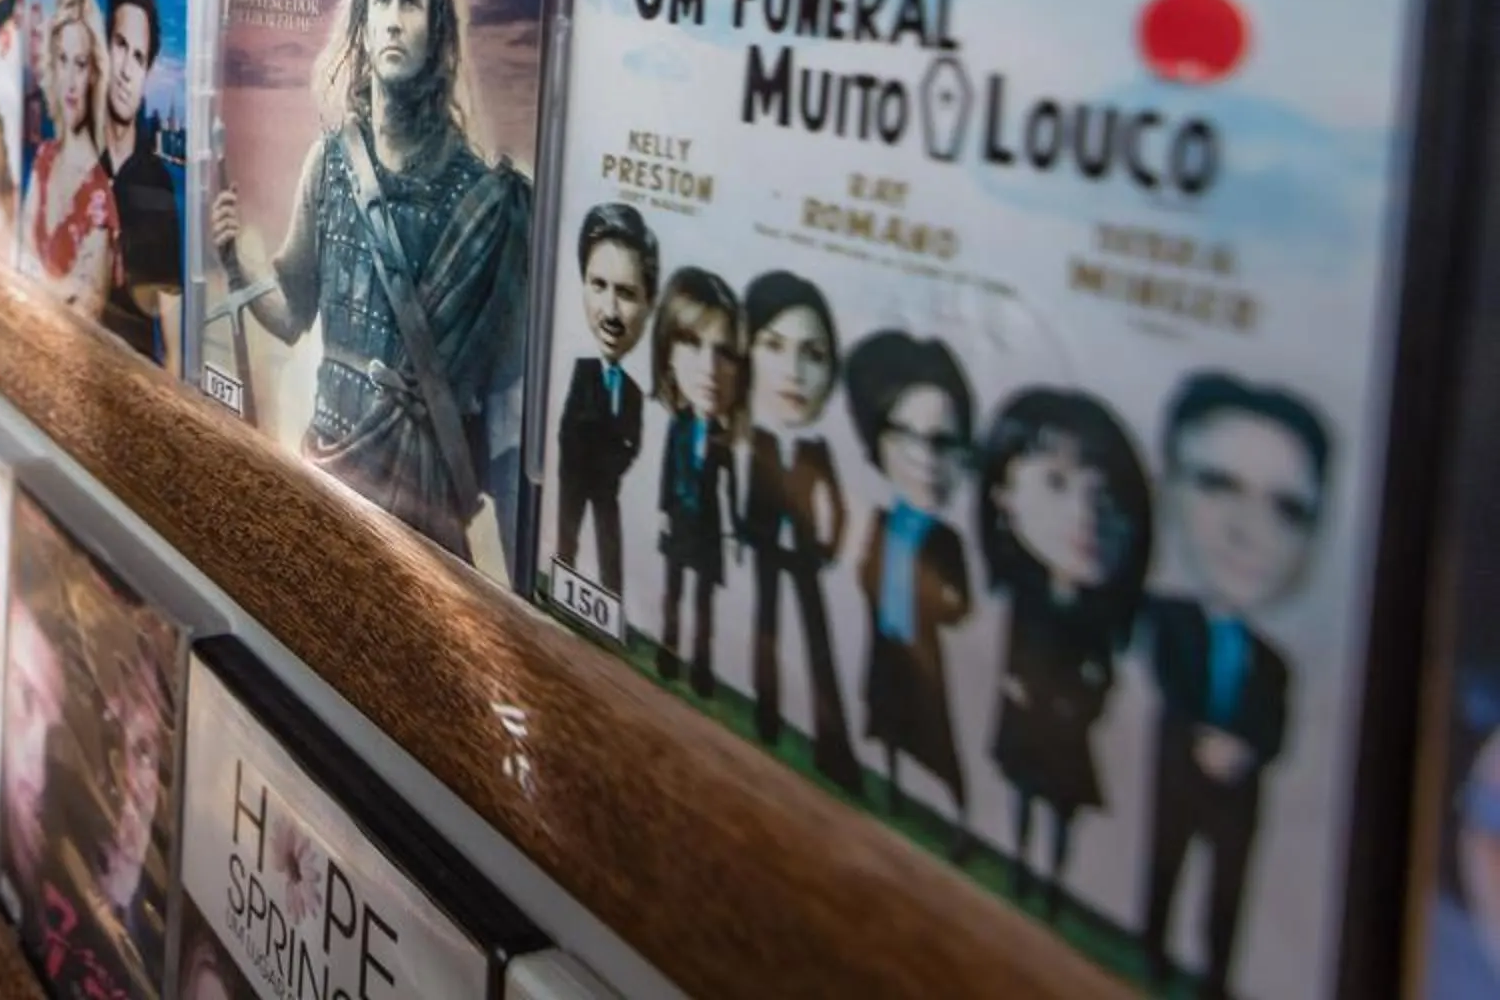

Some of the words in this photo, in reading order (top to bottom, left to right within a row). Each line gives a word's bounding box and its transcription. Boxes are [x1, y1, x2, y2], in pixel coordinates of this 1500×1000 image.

[629, 129, 693, 162] KELLY
[740, 43, 911, 147] MUITO
[982, 71, 1222, 197] LOUCO
[602, 153, 715, 204] PRESTON
[563, 580, 609, 627] 150
[227, 853, 349, 1000] SPRIN
